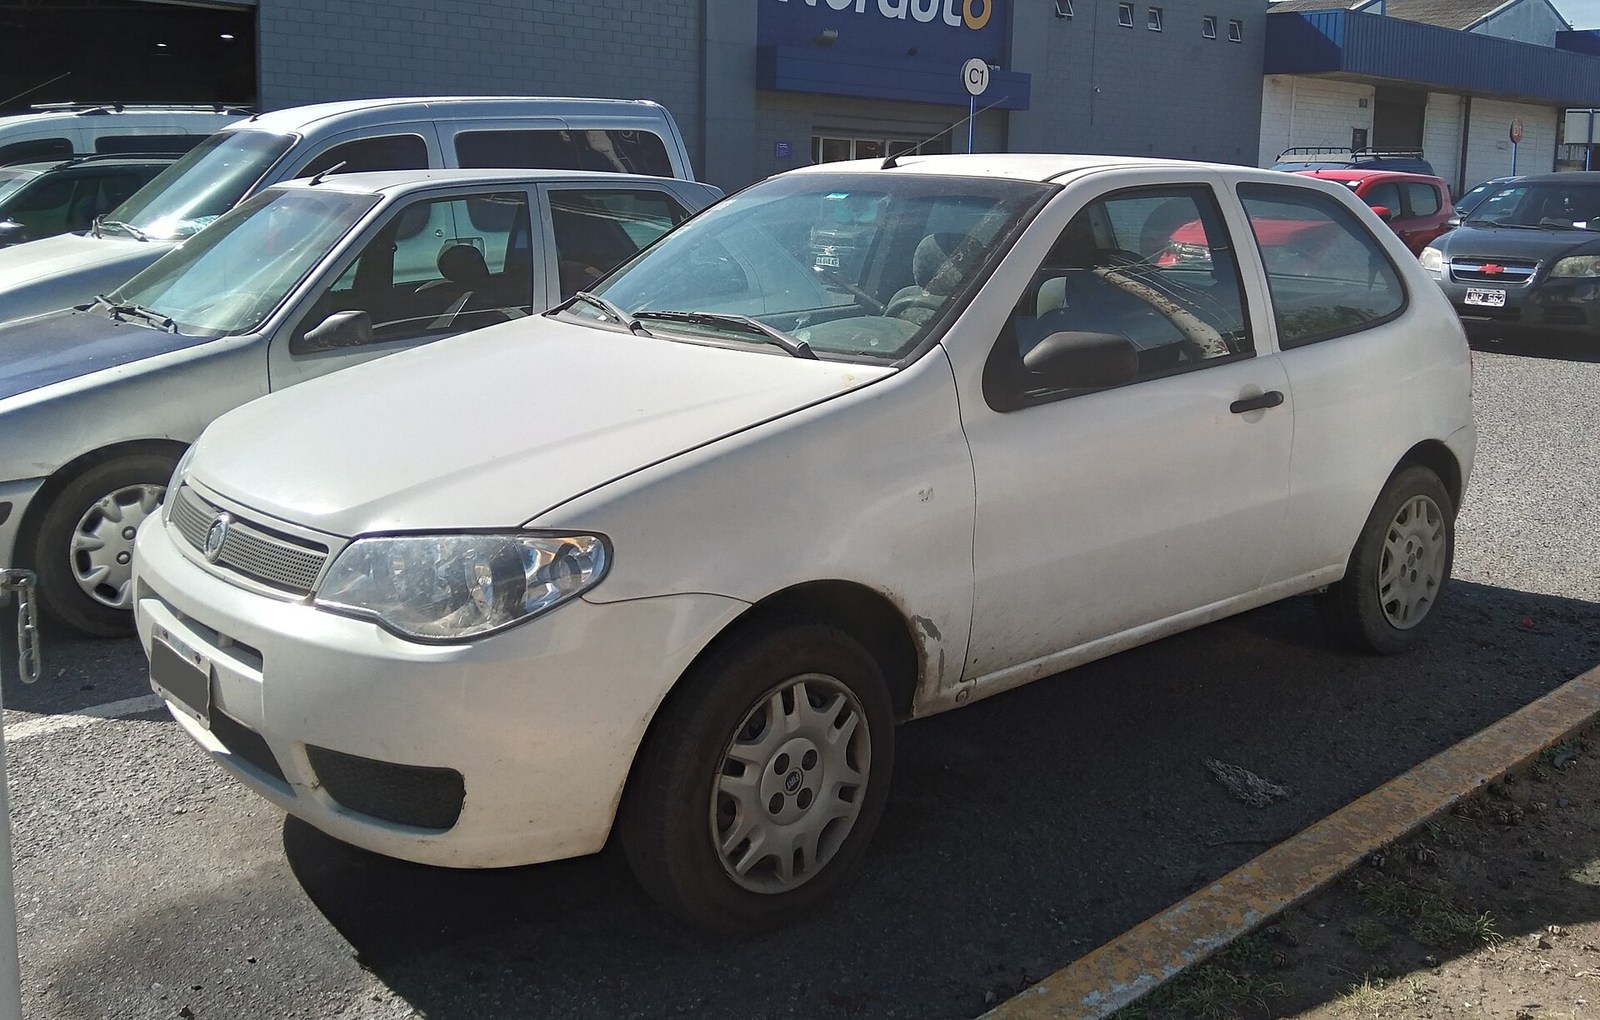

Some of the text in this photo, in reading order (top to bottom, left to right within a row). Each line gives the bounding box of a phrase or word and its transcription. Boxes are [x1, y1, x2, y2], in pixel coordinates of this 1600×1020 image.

[778, 0, 992, 30] auto
[969, 67, 985, 86] C1
[1487, 293, 1504, 303] 562
